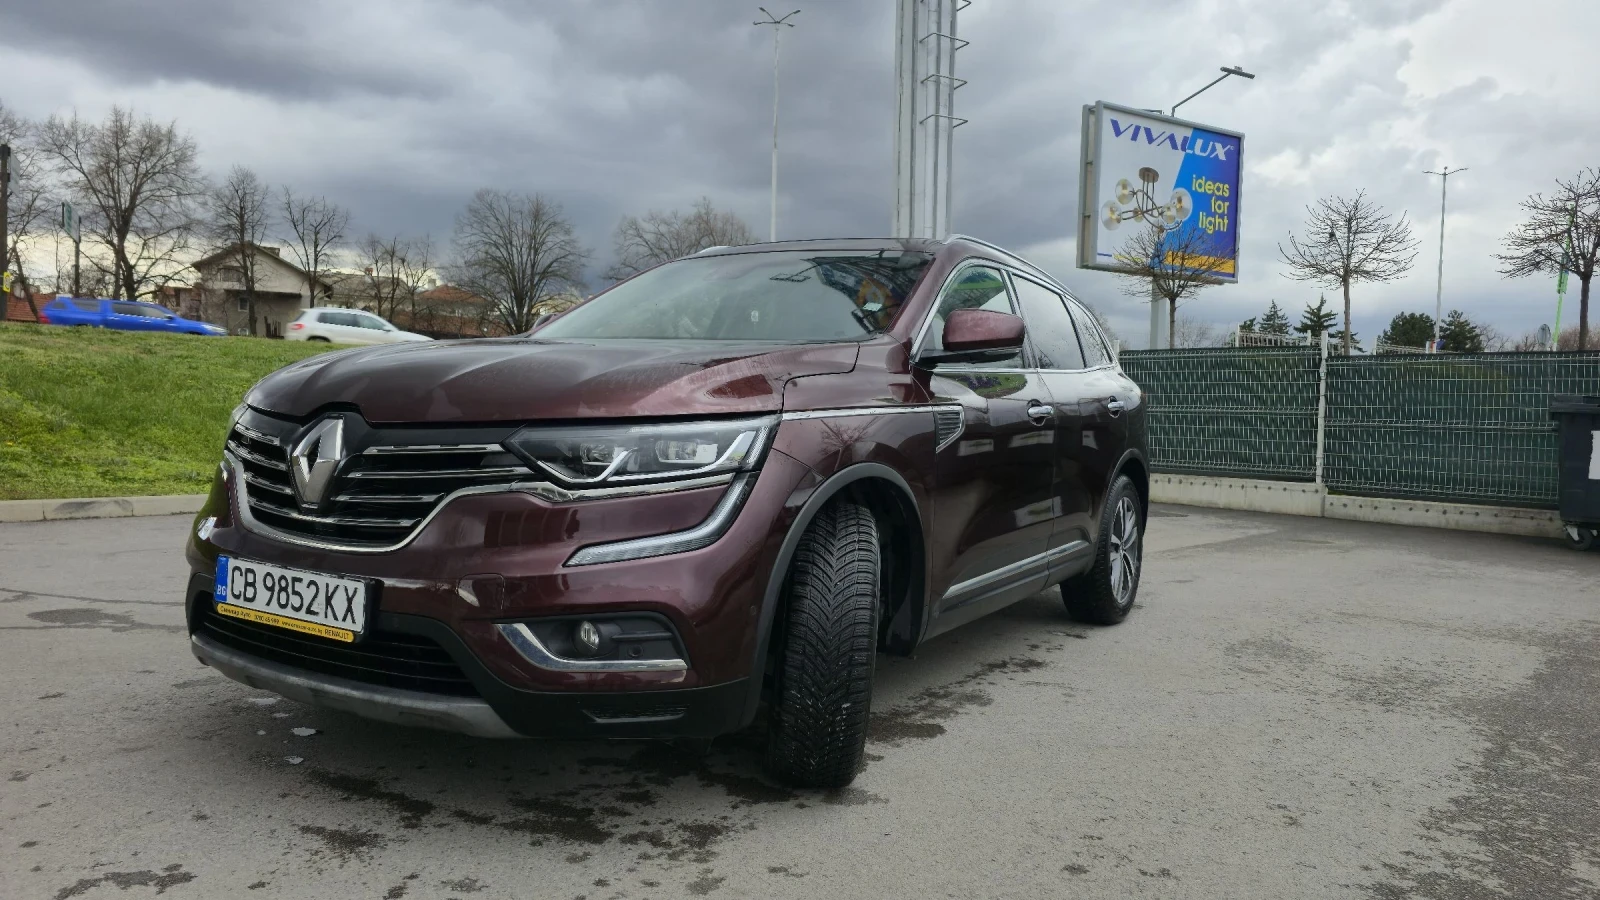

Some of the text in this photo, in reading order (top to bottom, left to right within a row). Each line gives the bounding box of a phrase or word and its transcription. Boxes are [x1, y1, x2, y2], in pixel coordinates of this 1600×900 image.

[1192, 174, 1230, 197] ideas
[1211, 196, 1229, 214] for
[1199, 212, 1229, 234] light
[216, 584, 227, 596] BG
[231, 565, 358, 624] CB 9852 KX
[325, 628, 350, 640] RENAULT
